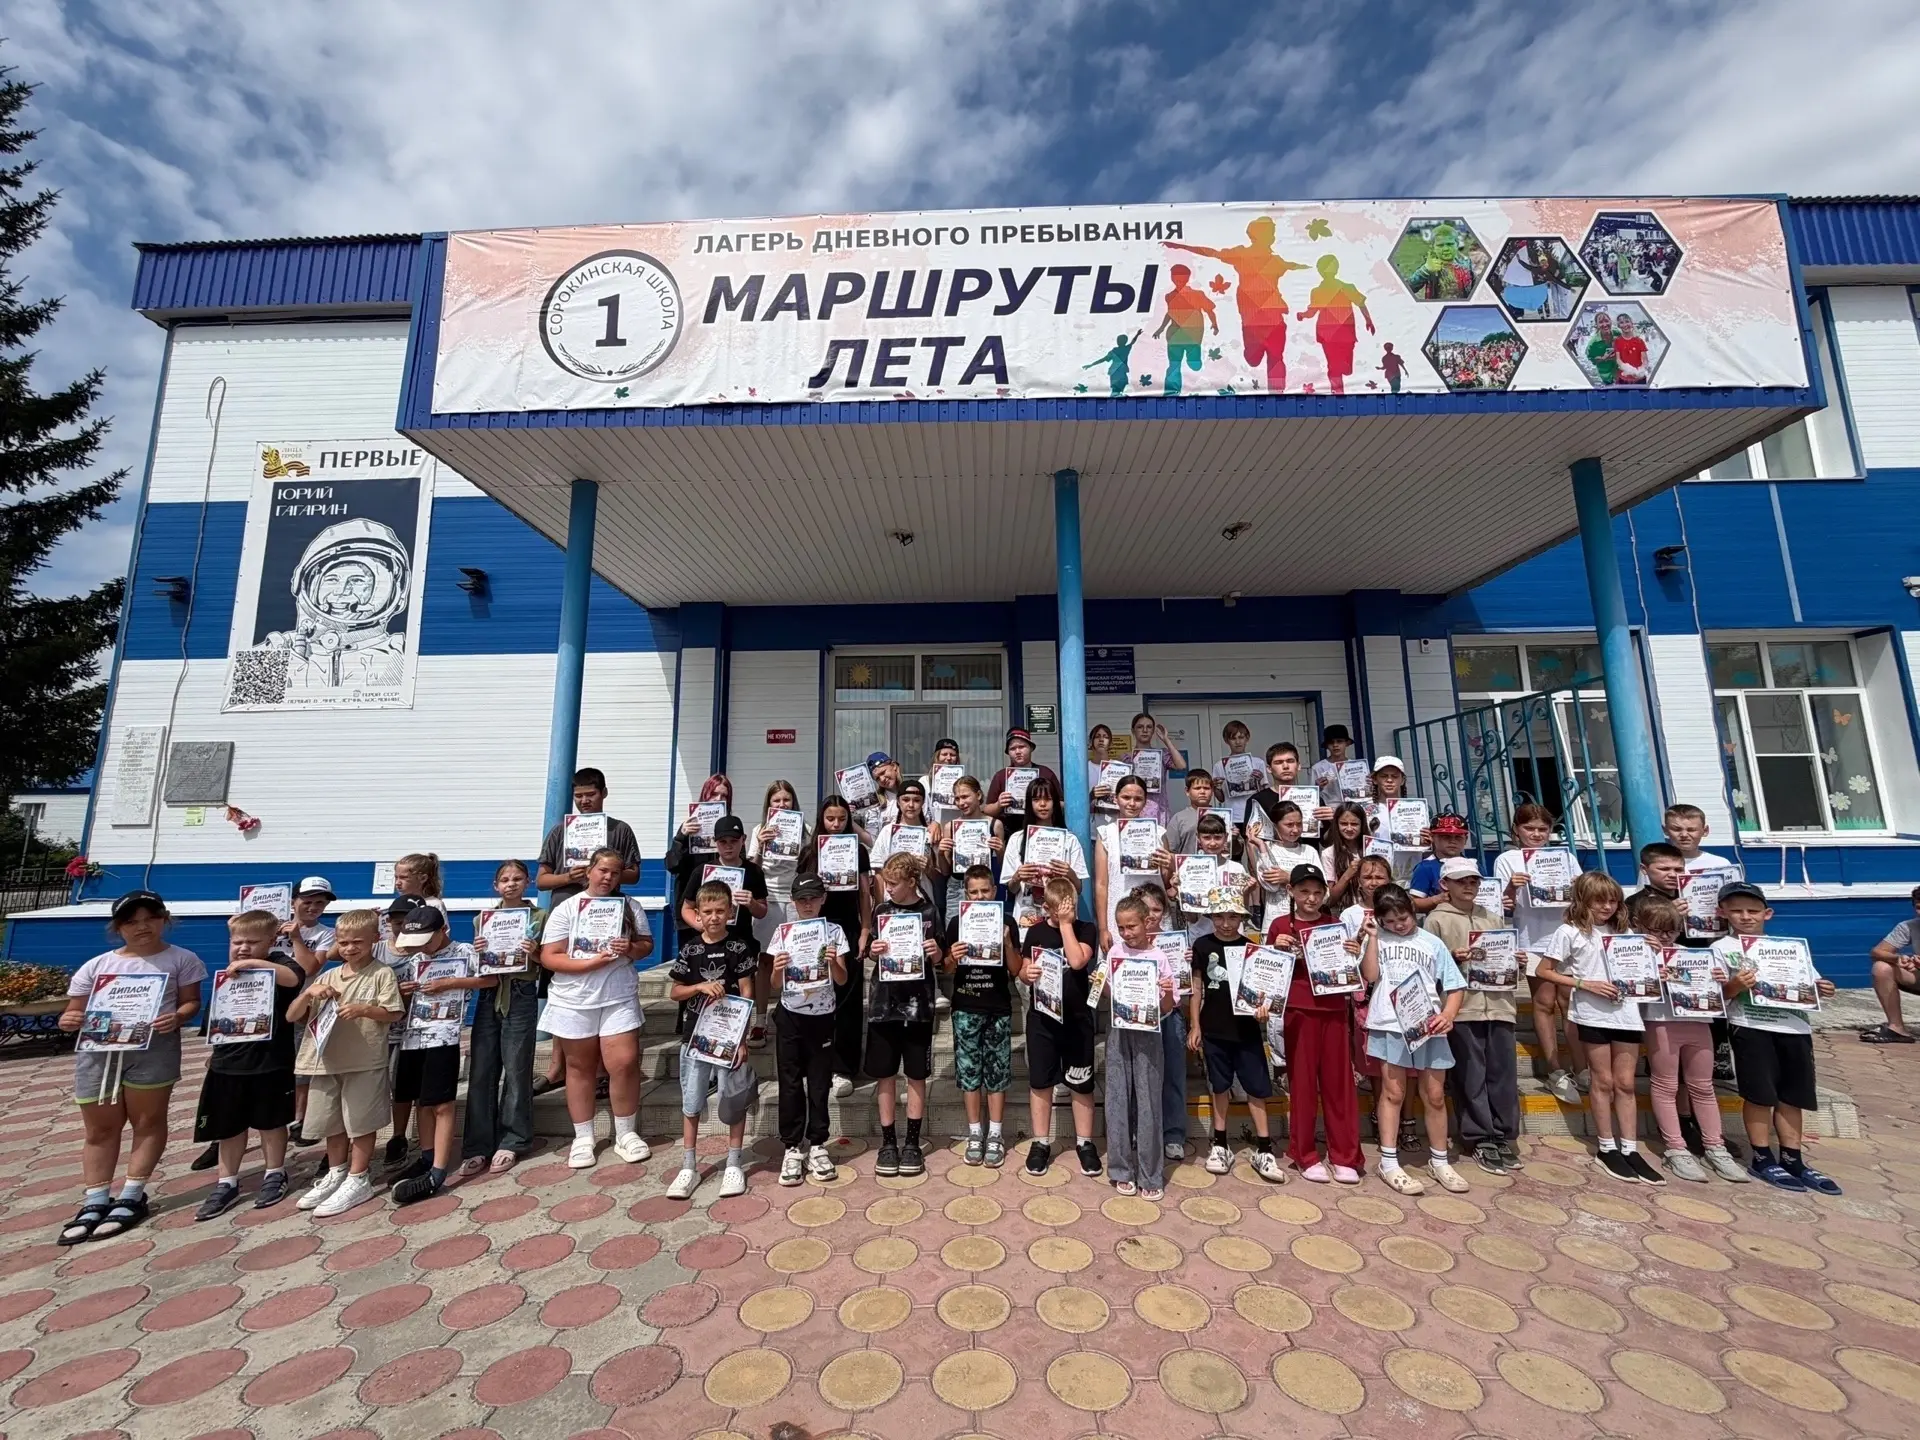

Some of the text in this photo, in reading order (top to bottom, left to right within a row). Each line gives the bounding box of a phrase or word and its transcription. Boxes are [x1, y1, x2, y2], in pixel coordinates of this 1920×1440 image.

[694, 221, 1183, 253] ЛАГЕРЬ ДНЕВНОГО ПРЕБЫВАНИЯ
[550, 261, 675, 336] СОРОКИНСКАЯ ШКОЛА
[702, 264, 1159, 324] МАРШРУТЫ
[596, 294, 627, 347] 1
[808, 336, 1009, 388] ЛЕТА
[319, 449, 422, 468] ПЕРВЫЕ
[278, 486, 333, 500] ЮРИЙ
[276, 504, 348, 517] ГАГАРИН
[1229, 760, 1247, 768] ДИПЛОМ
[845, 772, 864, 783] ДИПЛОМ
[575, 821, 600, 829] ДИПЛОМ
[827, 843, 851, 851] ДИПЛОМ
[1535, 857, 1562, 865] ДИПЛОМ
[1692, 884, 1718, 893] ДИПЛОМ
[252, 892, 283, 903] ДИПЛОМ
[588, 907, 616, 915] ДИПЛОМ
[969, 912, 995, 920] ДИПЛОМ
[491, 918, 521, 929] ДИПЛОМ
[888, 924, 914, 934] ДИПЛОМ
[792, 930, 819, 942] ДИПЛОМ
[1313, 934, 1341, 947] ДИПЛОМ
[1481, 939, 1510, 949] ДИПЛОМ
[1613, 945, 1644, 954] ДИПЛОМ
[1758, 948, 1797, 957] ДИПЛОМ
[1041, 960, 1059, 970] ДИПЛОМ
[1254, 957, 1283, 969] ДИПЛОМ
[1676, 959, 1709, 967] ДИПЛОМ
[427, 968, 457, 979] ДИПЛОМ
[108, 985, 151, 996] ДИПЛОМ
[229, 980, 265, 991] ДИПЛОМ
[1400, 984, 1419, 1002] ДИПЛОМ
[713, 1006, 742, 1015] ДИПЛОМ
